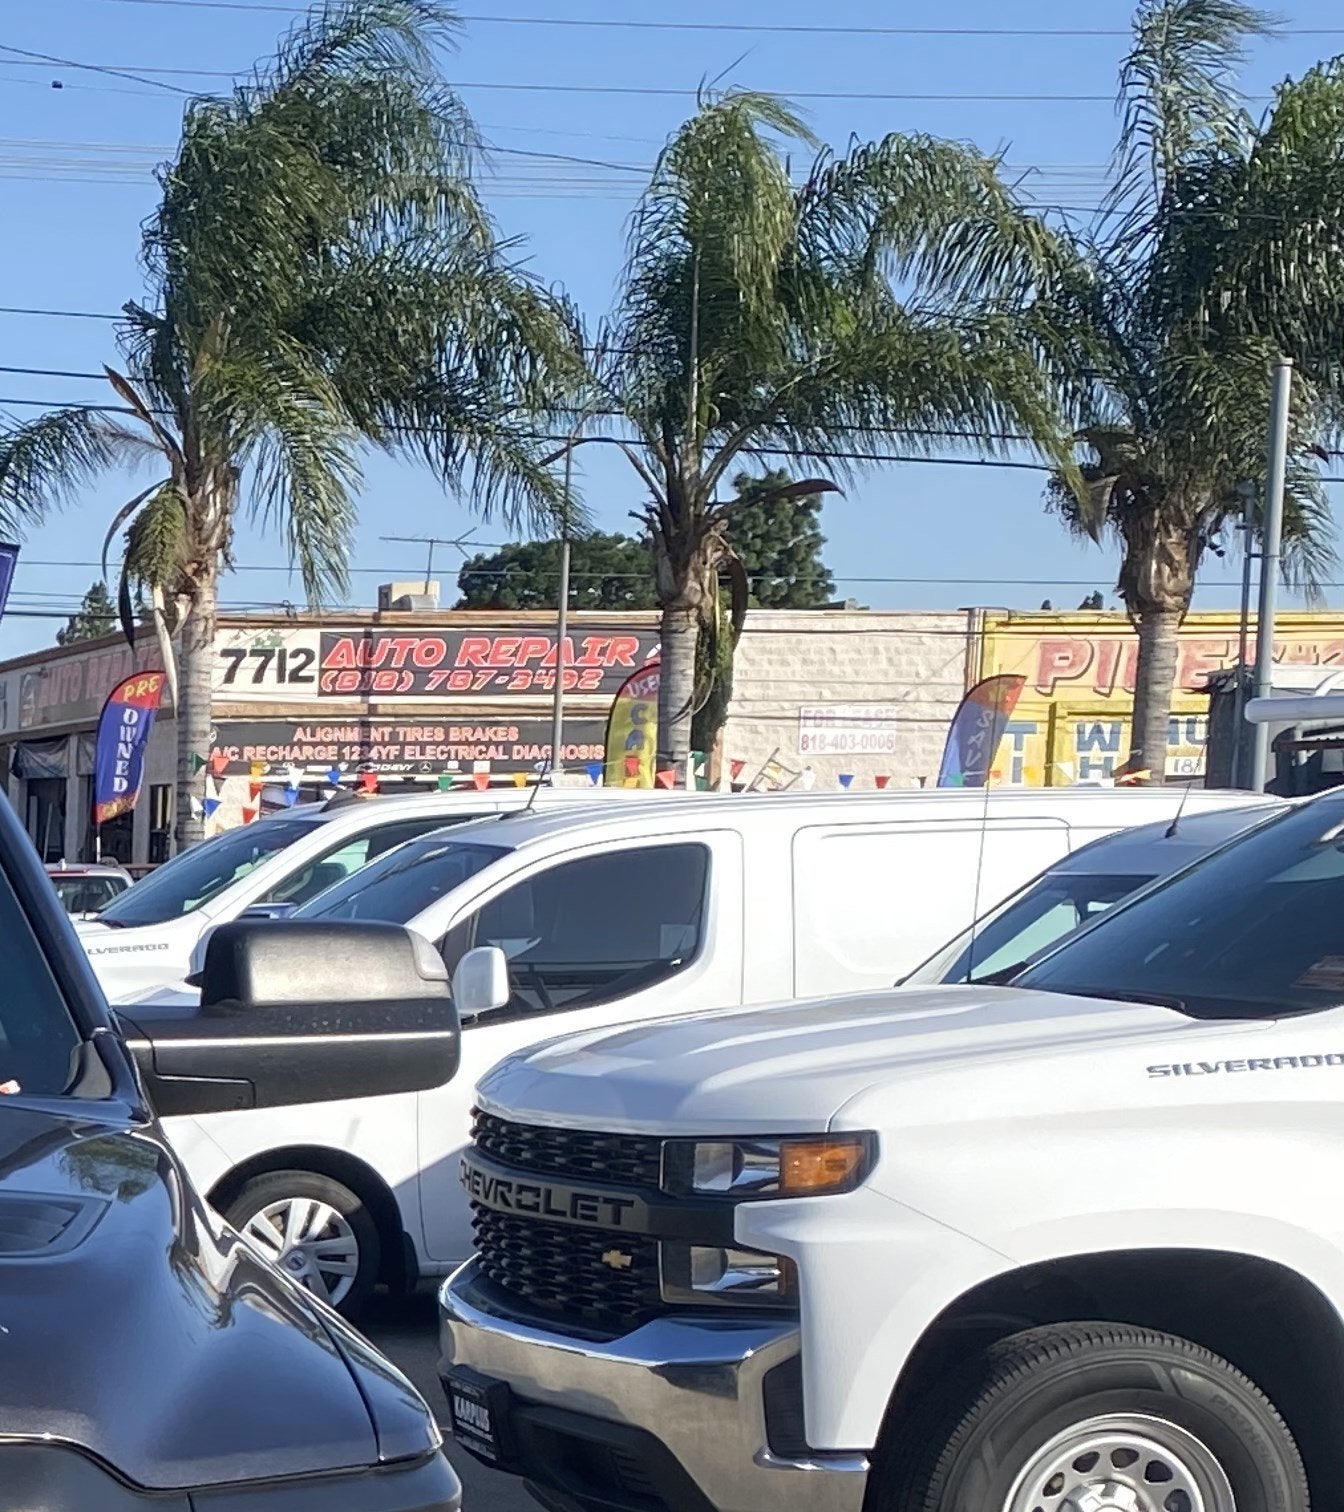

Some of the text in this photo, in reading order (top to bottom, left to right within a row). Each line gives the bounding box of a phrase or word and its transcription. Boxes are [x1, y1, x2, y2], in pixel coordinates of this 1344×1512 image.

[321, 636, 640, 668] AUTO REPAIR
[220, 648, 315, 684] 7712
[123, 674, 160, 702] PRE
[320, 669, 415, 692] (818)
[626, 674, 660, 698] USE
[293, 726, 519, 742] ALIGNMENT TIRES BRAKES
[113, 708, 140, 793] OWNED
[243, 746, 338, 761] RECHARGE
[404, 744, 509, 760] ELECTRICAL
[87, 943, 169, 955] LVERADO
[1146, 1053, 1344, 1079] SILVERADO
